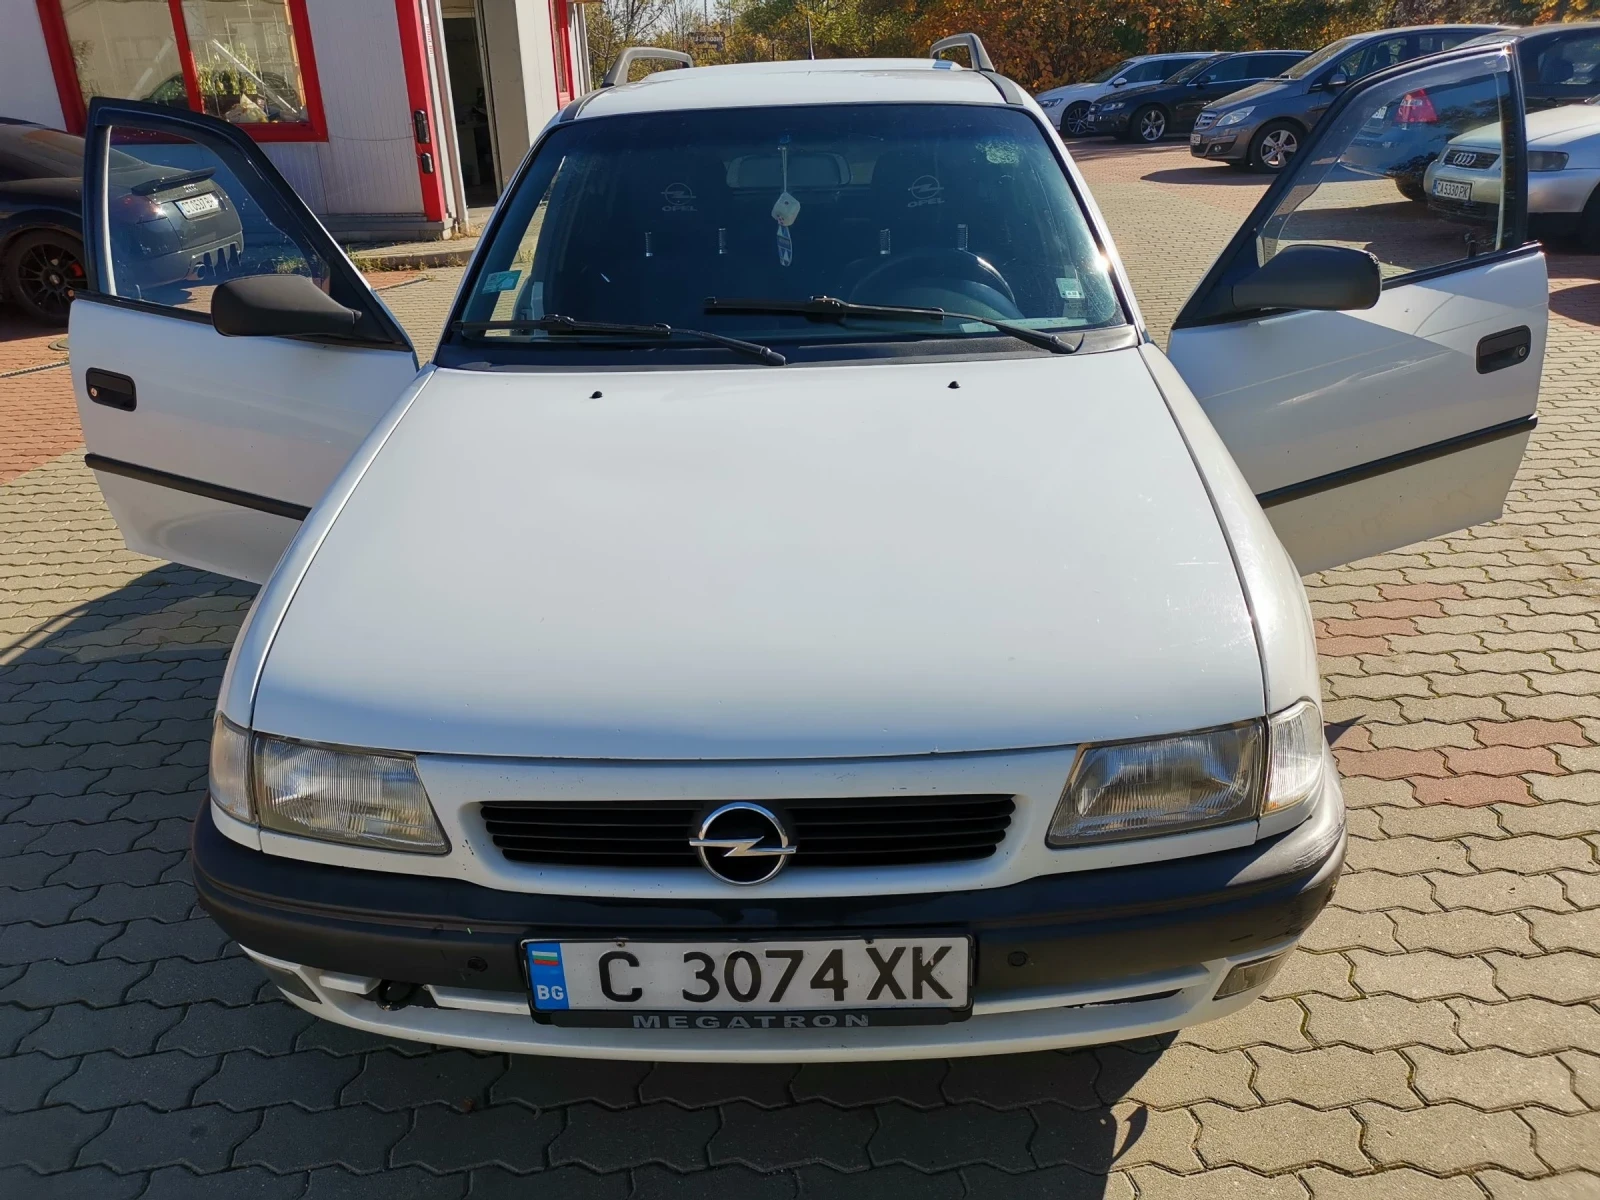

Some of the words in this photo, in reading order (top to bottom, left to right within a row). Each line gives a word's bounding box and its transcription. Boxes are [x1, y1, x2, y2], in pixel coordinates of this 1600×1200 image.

[908, 198, 945, 207] OPEL
[598, 950, 643, 1003] C
[682, 948, 849, 1003] 3074
[865, 945, 953, 1001] XK
[536, 984, 564, 1000] BG
[632, 1014, 869, 1029] MEGATRON
